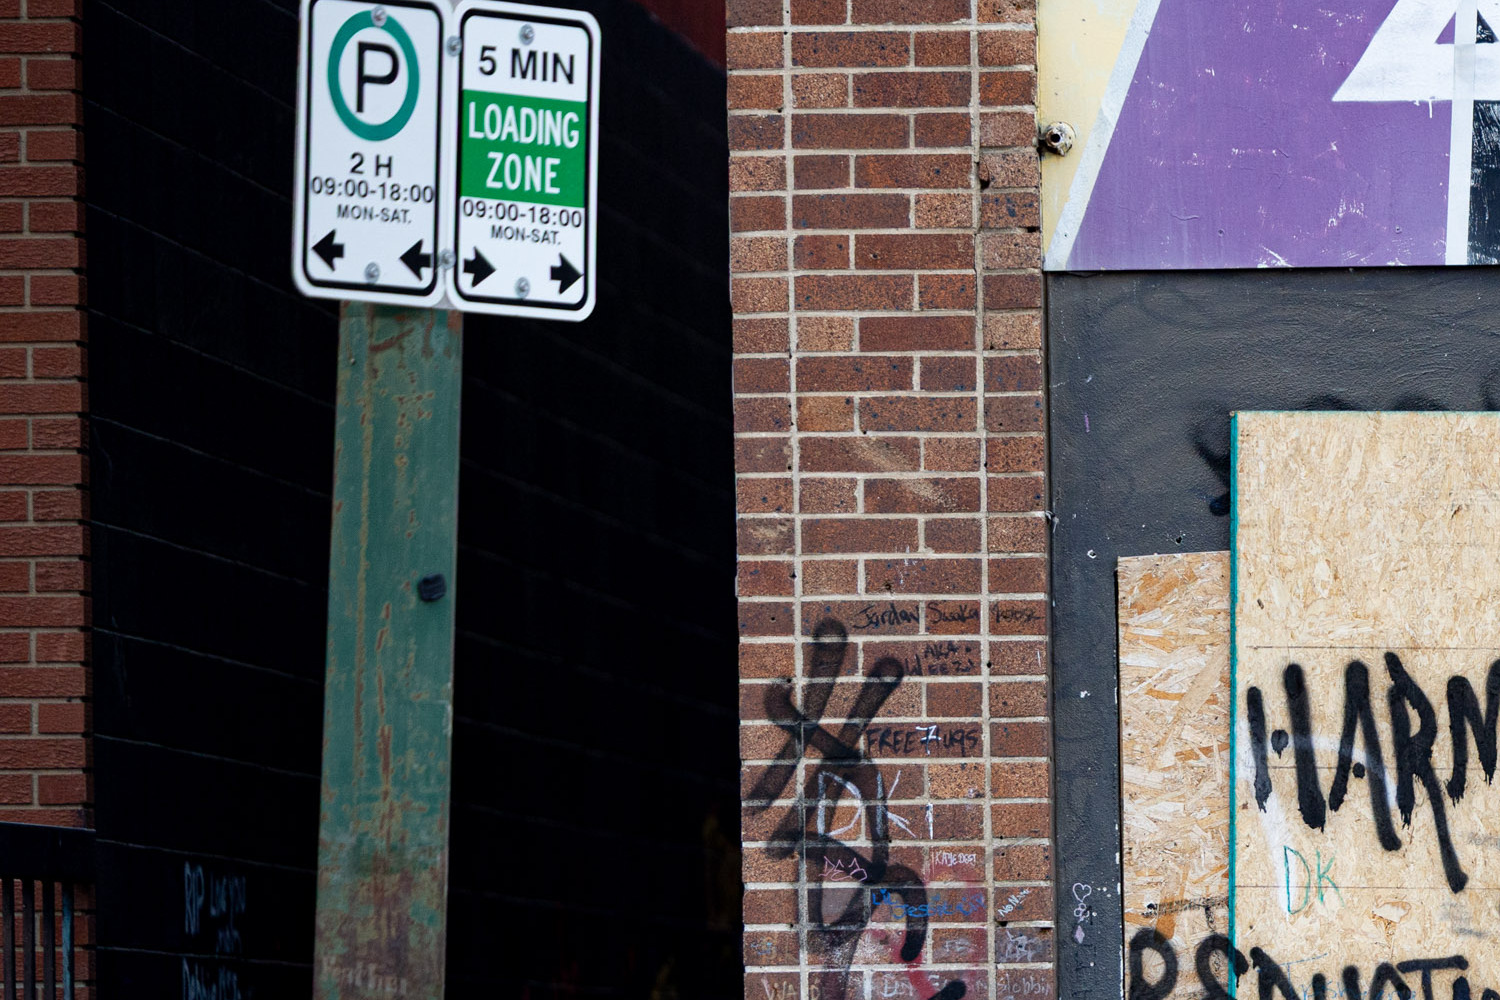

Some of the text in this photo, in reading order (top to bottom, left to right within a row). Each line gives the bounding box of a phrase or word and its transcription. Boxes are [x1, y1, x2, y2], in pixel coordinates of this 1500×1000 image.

[356, 42, 400, 113] P
[478, 46, 576, 85] 5 MIN
[468, 101, 580, 149] LOADING
[349, 153, 394, 178] 2 H
[486, 151, 561, 195] ZONE
[311, 176, 435, 204] 09:00-18:00
[336, 204, 413, 225] MON-SAT.
[463, 199, 583, 228] 09:00-18:00
[491, 225, 562, 247] MON-SAT.
[866, 727, 917, 756] FREE
